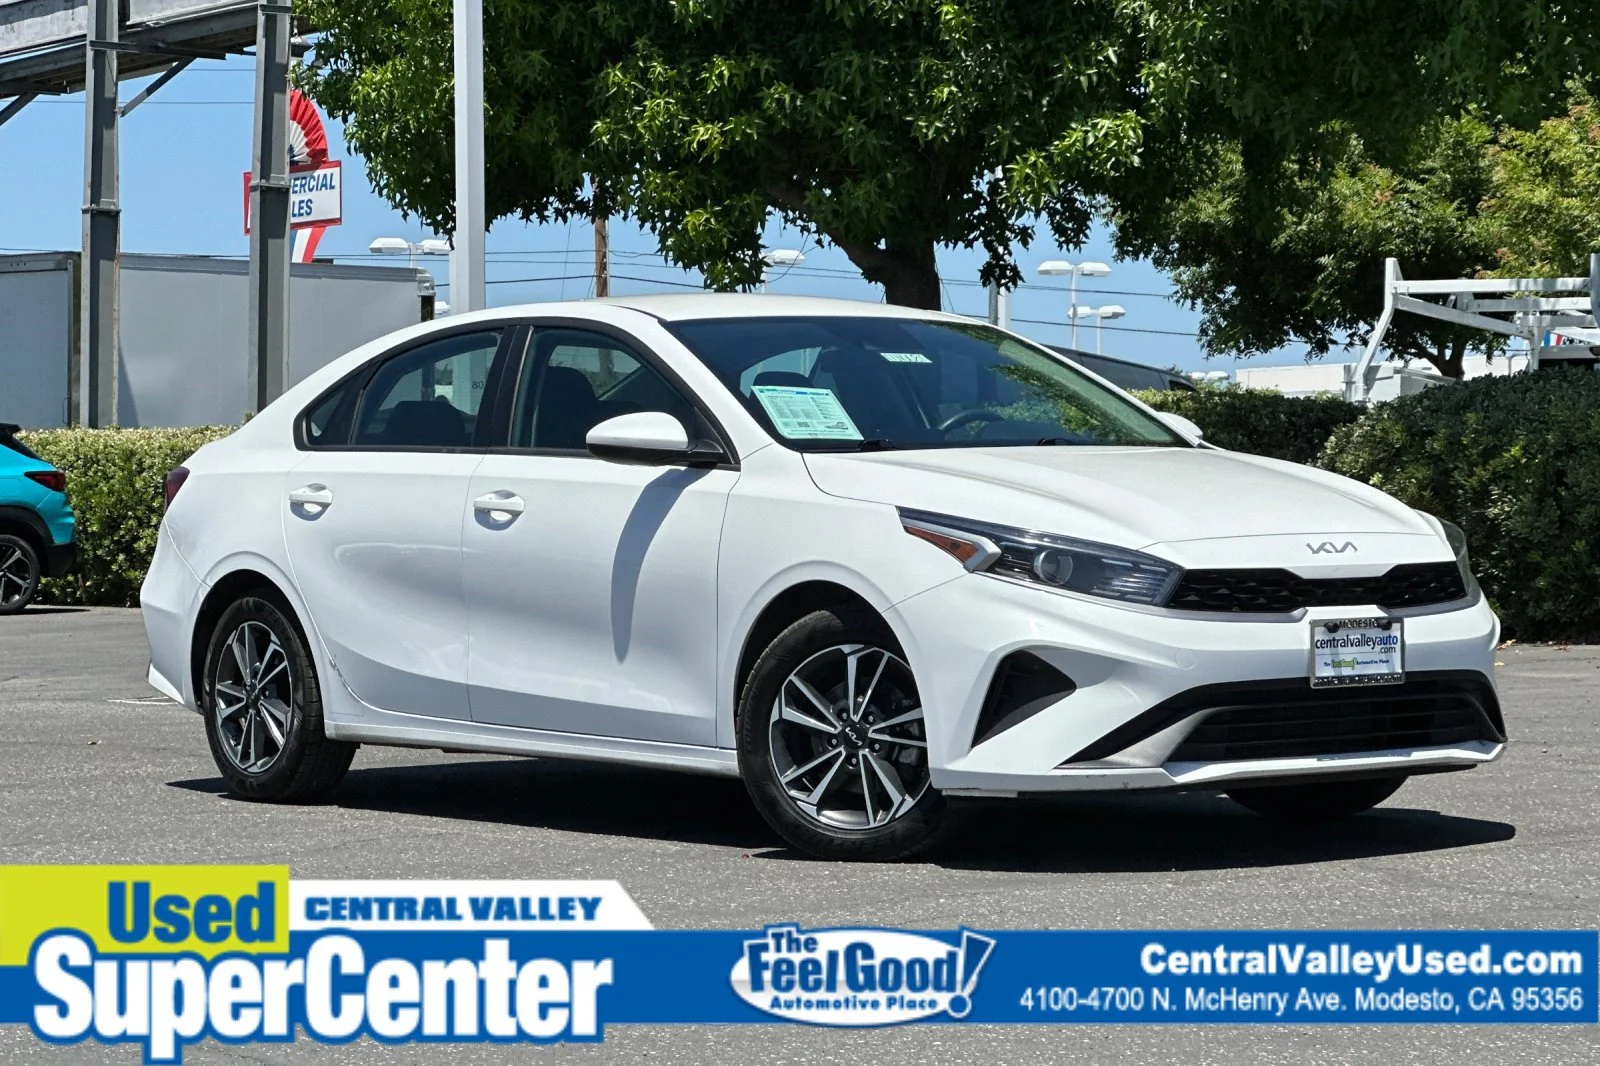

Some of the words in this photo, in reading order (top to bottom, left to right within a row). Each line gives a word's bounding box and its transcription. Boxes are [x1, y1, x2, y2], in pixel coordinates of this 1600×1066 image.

[291, 173, 335, 194] ERCIAL
[291, 198, 313, 217] LES
[1306, 541, 1358, 555] KIA
[1315, 633, 1398, 650] centralvalleyauto
